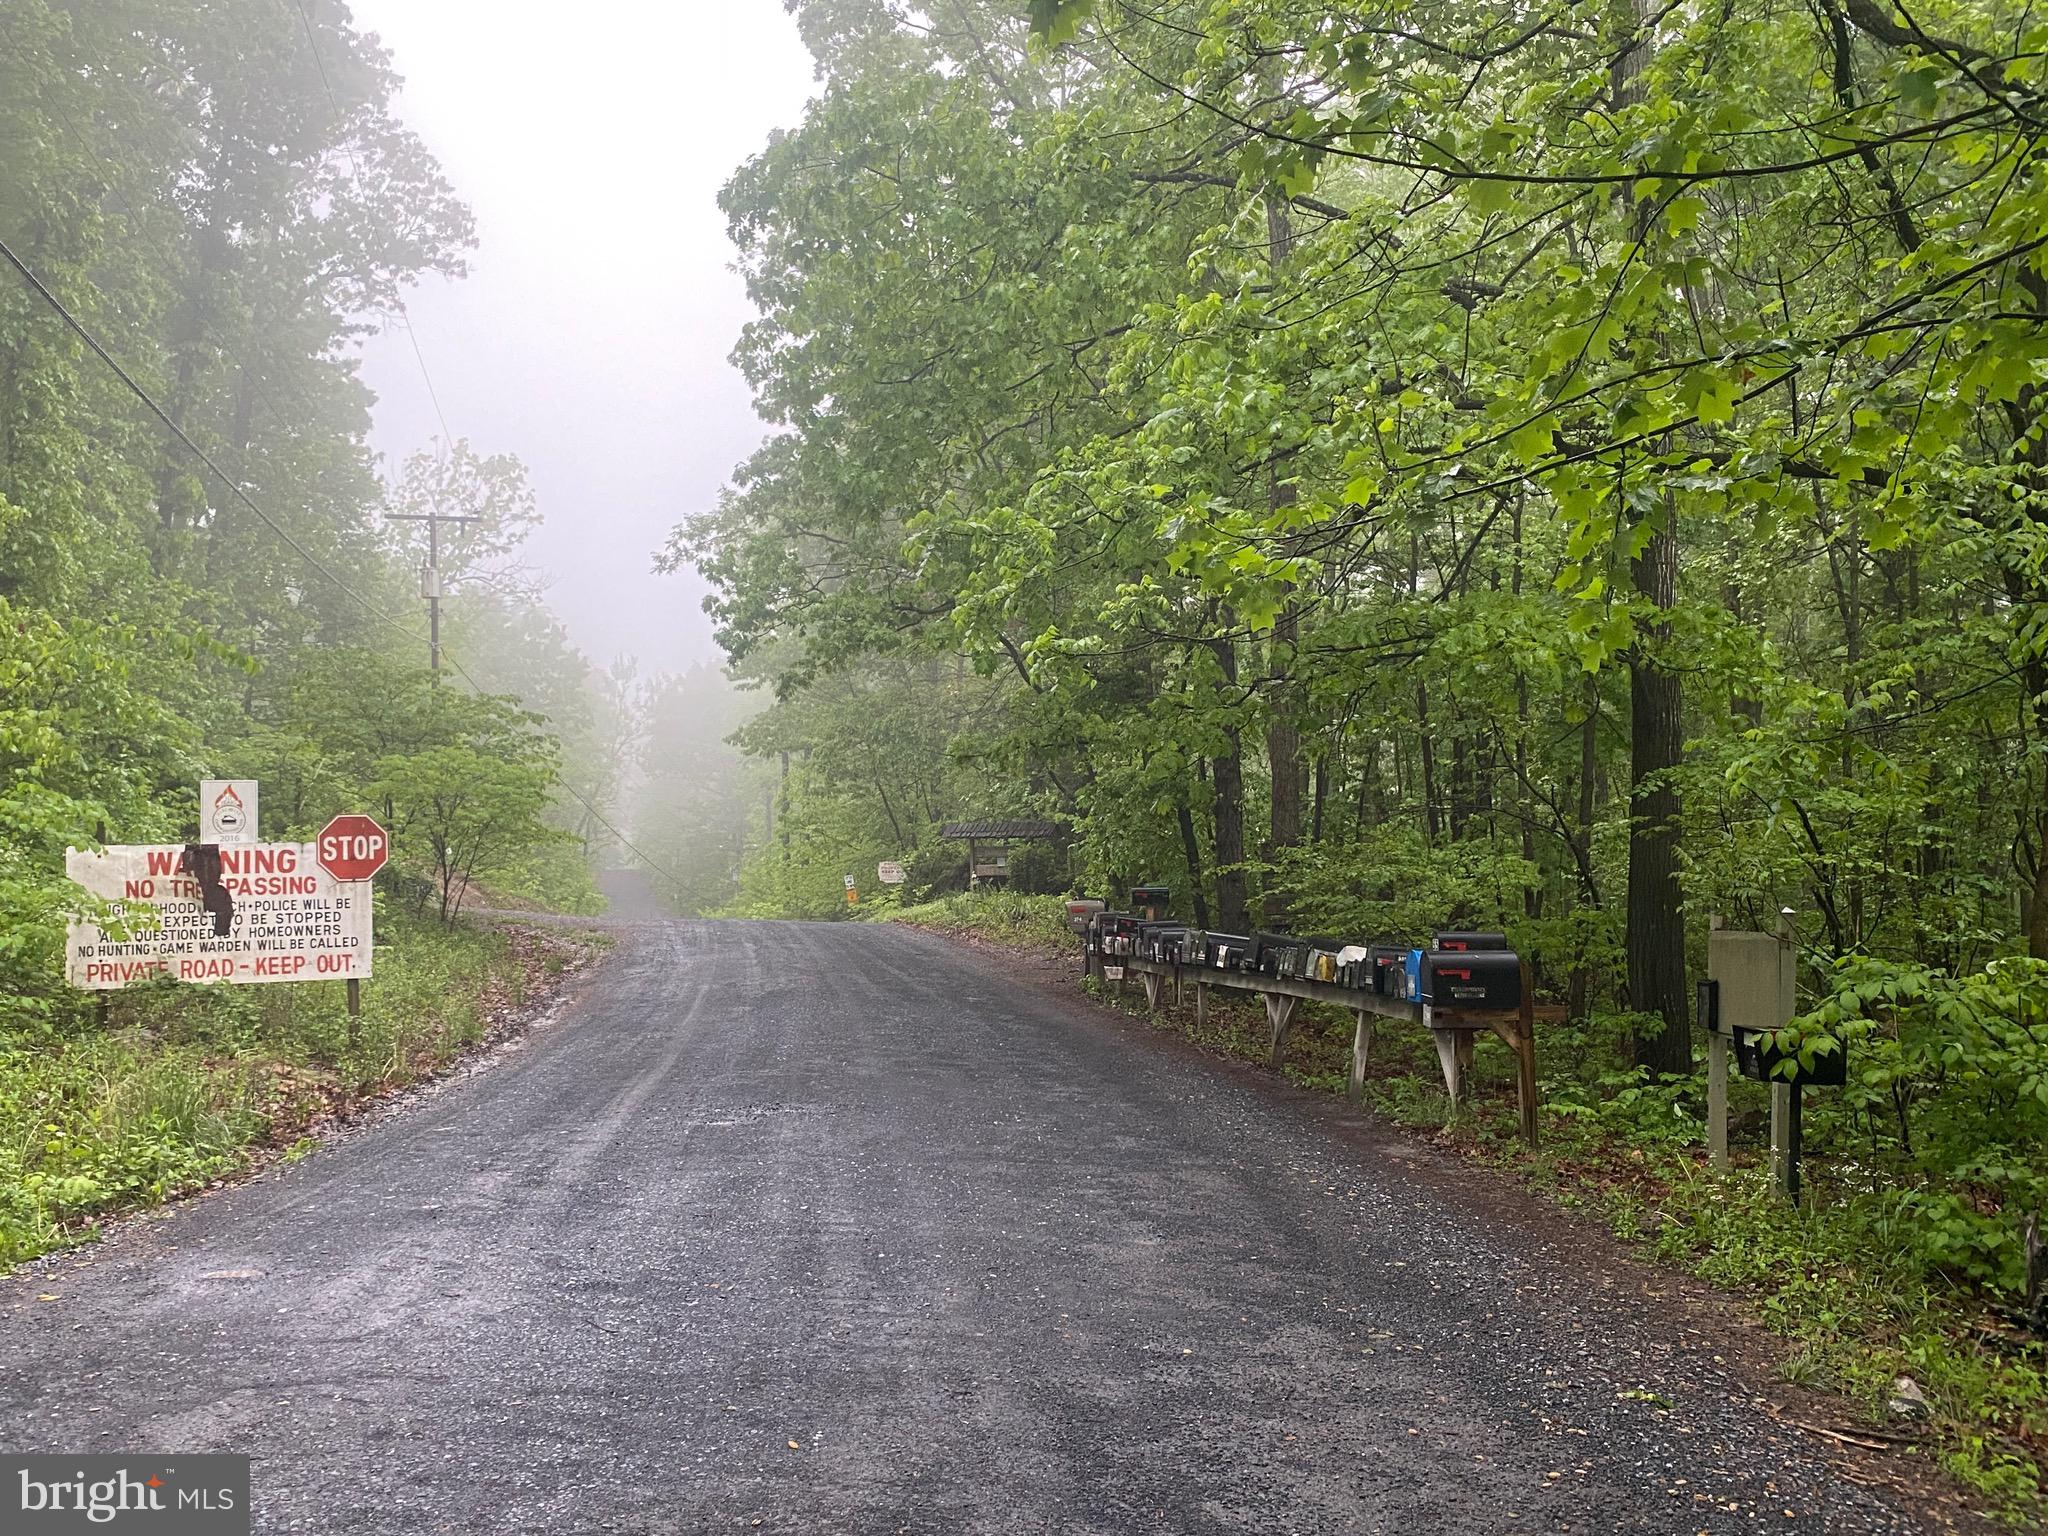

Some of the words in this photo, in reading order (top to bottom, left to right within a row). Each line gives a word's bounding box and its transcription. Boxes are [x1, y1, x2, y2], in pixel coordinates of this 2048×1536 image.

[322, 835, 383, 861] STOP
[147, 849, 297, 876] WANING
[125, 879, 155, 899] NO
[170, 876, 317, 898] TREPASSING
[254, 900, 297, 911] POLICE
[303, 899, 330, 910] WILL
[336, 898, 351, 909] BE
[164, 916, 216, 927] EXPECT
[251, 913, 268, 925] BE
[275, 911, 342, 924] STOPPED
[134, 929, 215, 943] QUESTIONED
[249, 924, 341, 938] HOMEOWNERS
[78, 945, 94, 957] NO
[98, 943, 150, 957] HUNTING
[159, 942, 193, 954] GAME
[199, 940, 251, 952] WARDEN
[257, 939, 286, 951] WILL
[290, 938, 305, 949] BE
[310, 936, 359, 949] CALLED
[86, 961, 169, 982] PRIVATE
[180, 958, 234, 980] ROAD
[255, 955, 305, 976] KEEP
[316, 953, 353, 974] OUT
